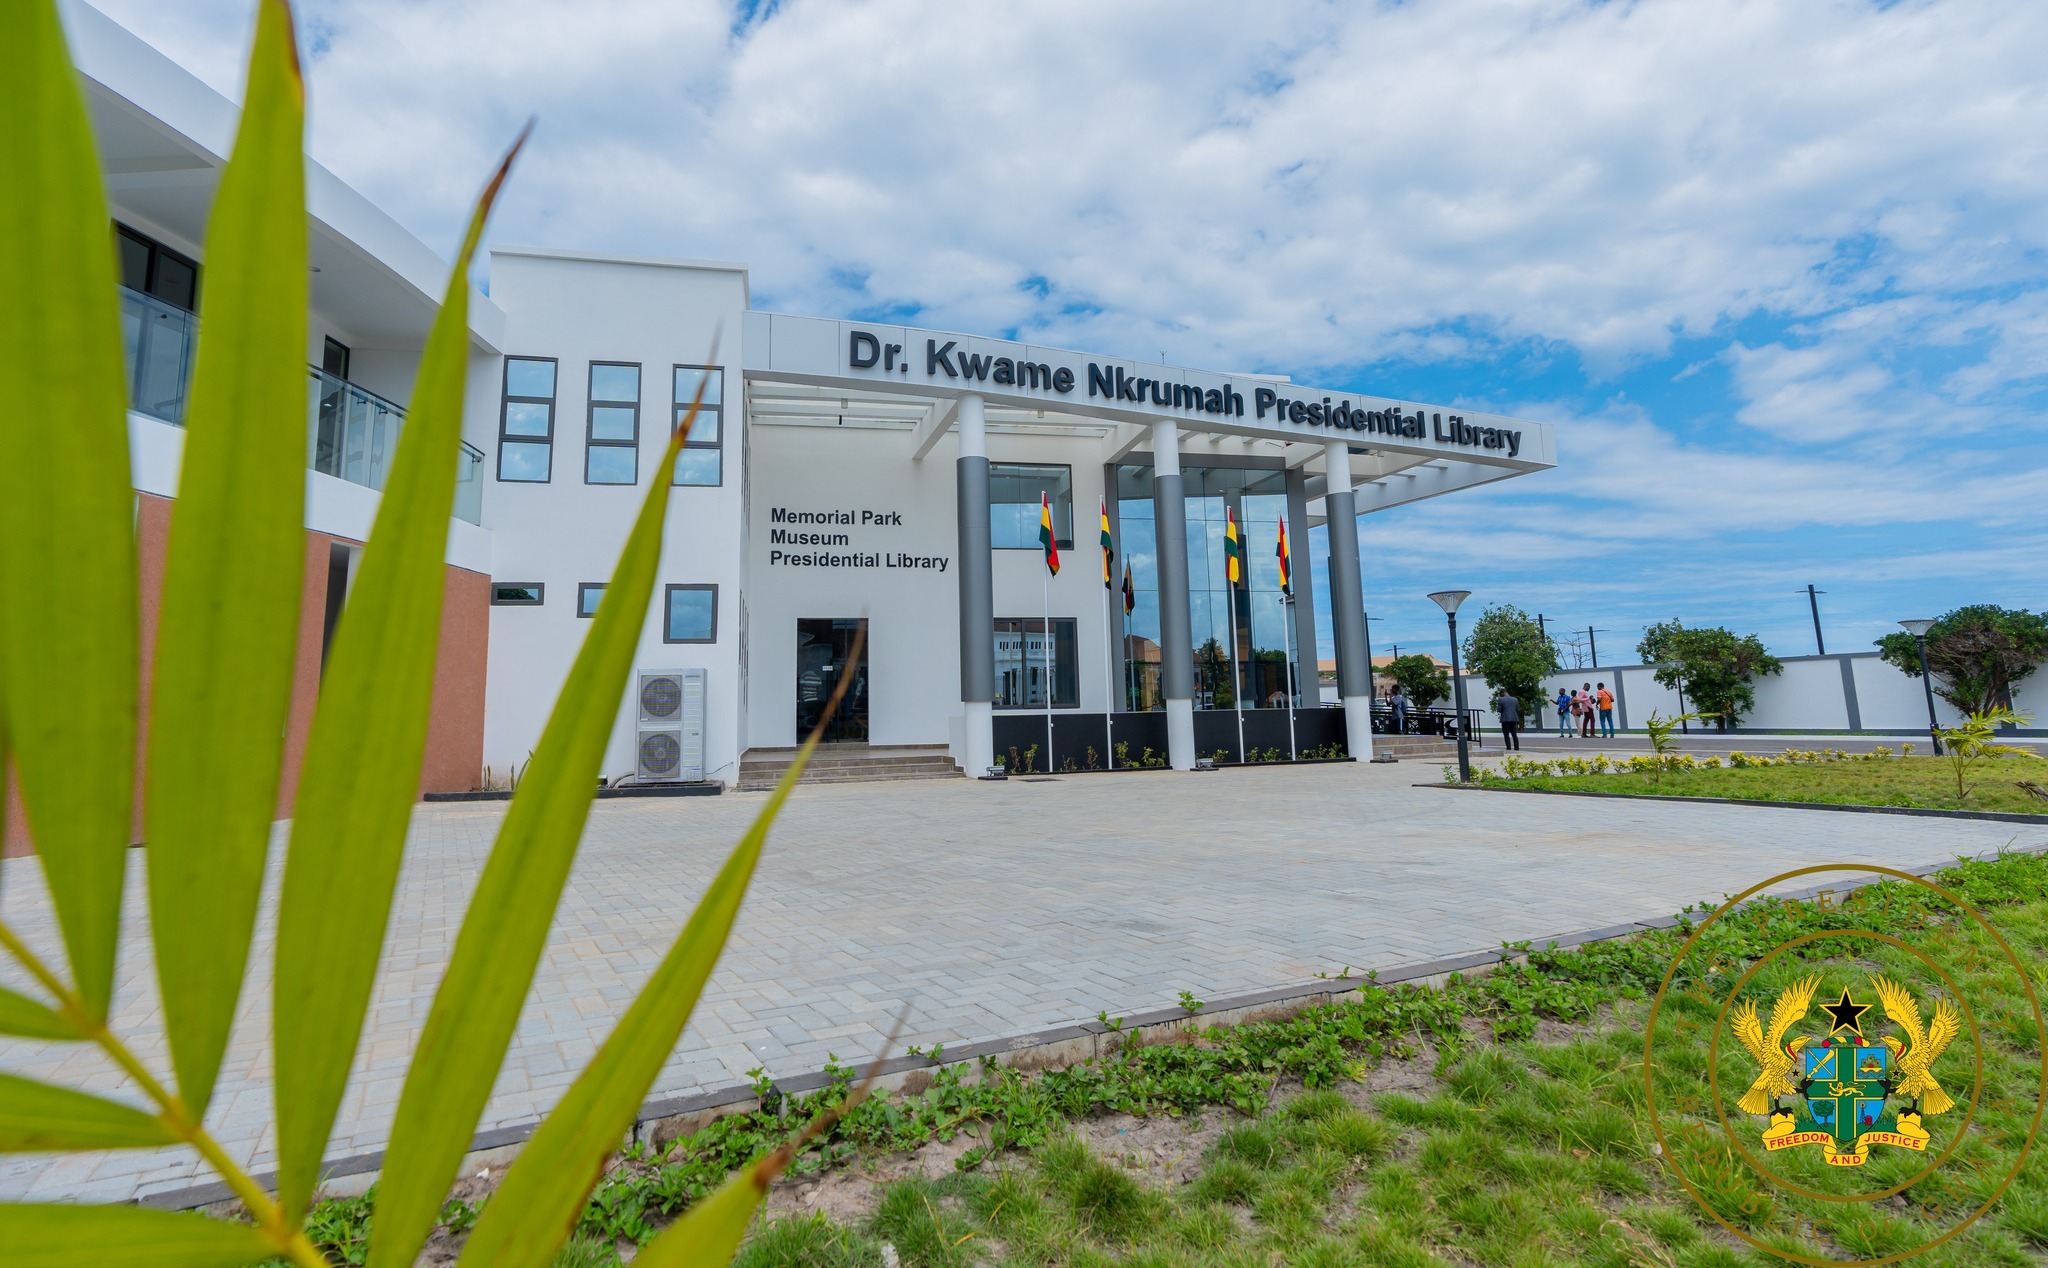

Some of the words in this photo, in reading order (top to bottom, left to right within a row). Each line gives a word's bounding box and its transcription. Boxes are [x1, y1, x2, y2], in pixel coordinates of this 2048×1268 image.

[850, 330, 908, 372] Dr.
[927, 339, 1075, 393] Kwame
[1088, 362, 1244, 417] Nkrumah
[1255, 387, 1427, 439] Presidential
[1433, 413, 1521, 457] Library
[771, 507, 856, 526] Memorial
[861, 510, 902, 526] Park
[770, 529, 849, 546] Museum
[770, 550, 880, 568] Presidential
[886, 553, 949, 573] Library
